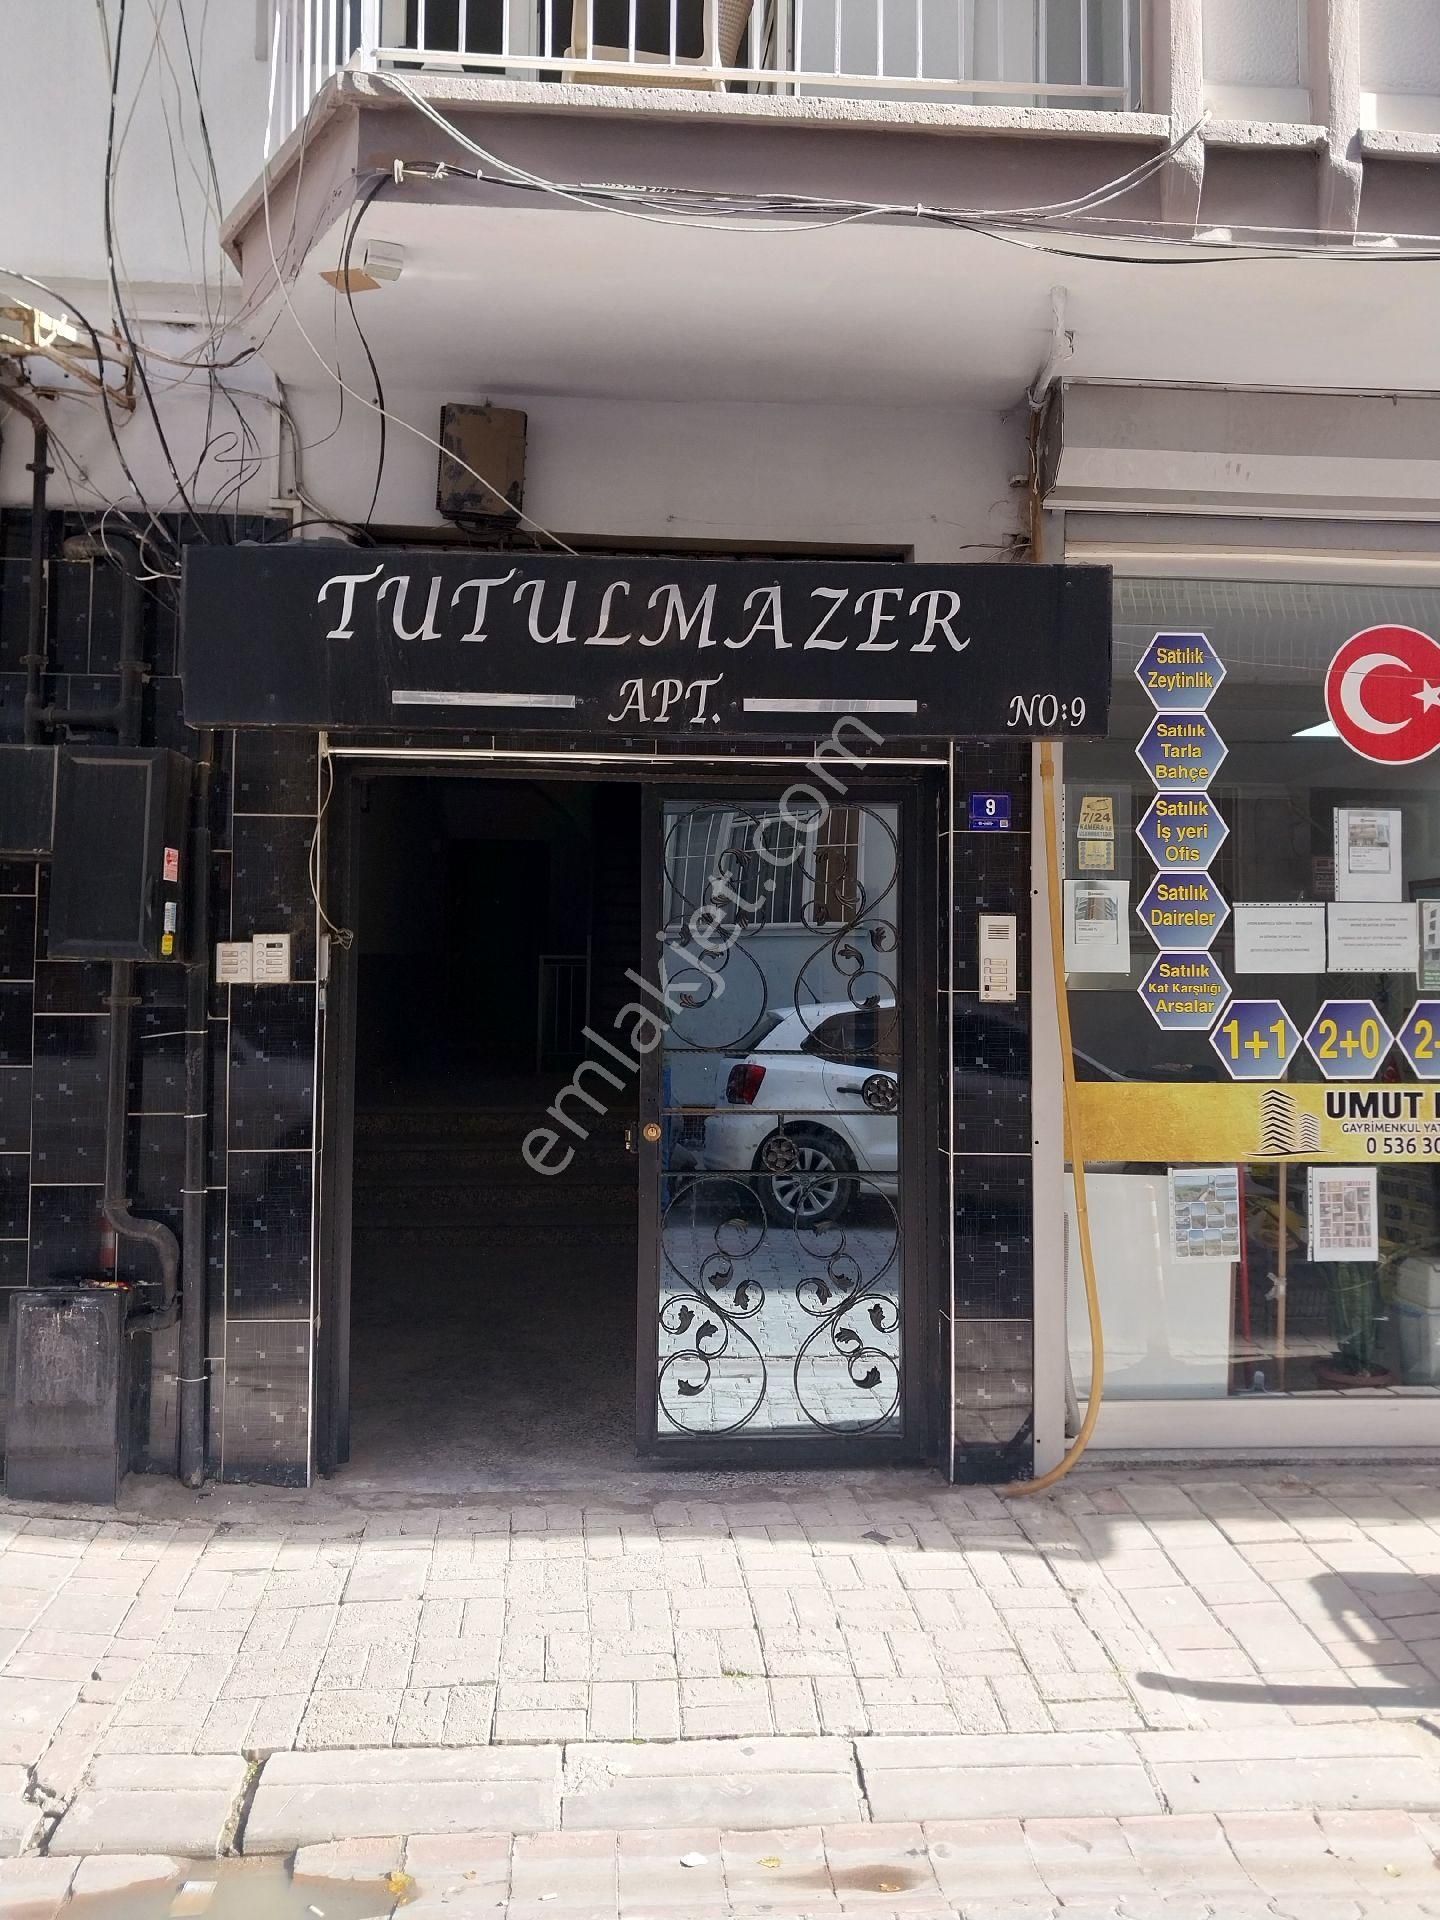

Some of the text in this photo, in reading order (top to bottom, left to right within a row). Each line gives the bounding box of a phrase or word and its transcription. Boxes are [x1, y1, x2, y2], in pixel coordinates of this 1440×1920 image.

[318, 563, 970, 653] TUTULMAZER
[1157, 648, 1204, 665] Satılık
[1148, 672, 1214, 691] Zeytinlik
[607, 672, 723, 725] APT.
[1006, 693, 1087, 727] NO:9
[1156, 724, 1206, 738] Satılık
[1161, 744, 1202, 758] Tarla
[1155, 765, 1209, 781] Bahçe
[986, 799, 996, 815] 9
[1156, 801, 1208, 816] Satılık
[1082, 812, 1111, 823] 7/24
[1157, 821, 1208, 842] İş yeri
[1165, 846, 1200, 862] Ofis
[1157, 885, 1208, 901] Satılık
[1151, 909, 1215, 926] Daireler
[1160, 964, 1209, 977] Satılık
[1148, 983, 1221, 996] Kat Karşılığı
[1156, 999, 1214, 1013] Arsalar
[1222, 1019, 1285, 1059] 1+1
[1319, 1019, 1379, 1059] 2+0
[1415, 1019, 1440, 1059] 2
[1326, 1092, 1423, 1119] UMUT
[1342, 1121, 1421, 1133] GAYRİMENKUL
[1367, 1137, 1377, 1154] 0
[1383, 1137, 1417, 1154] 536
